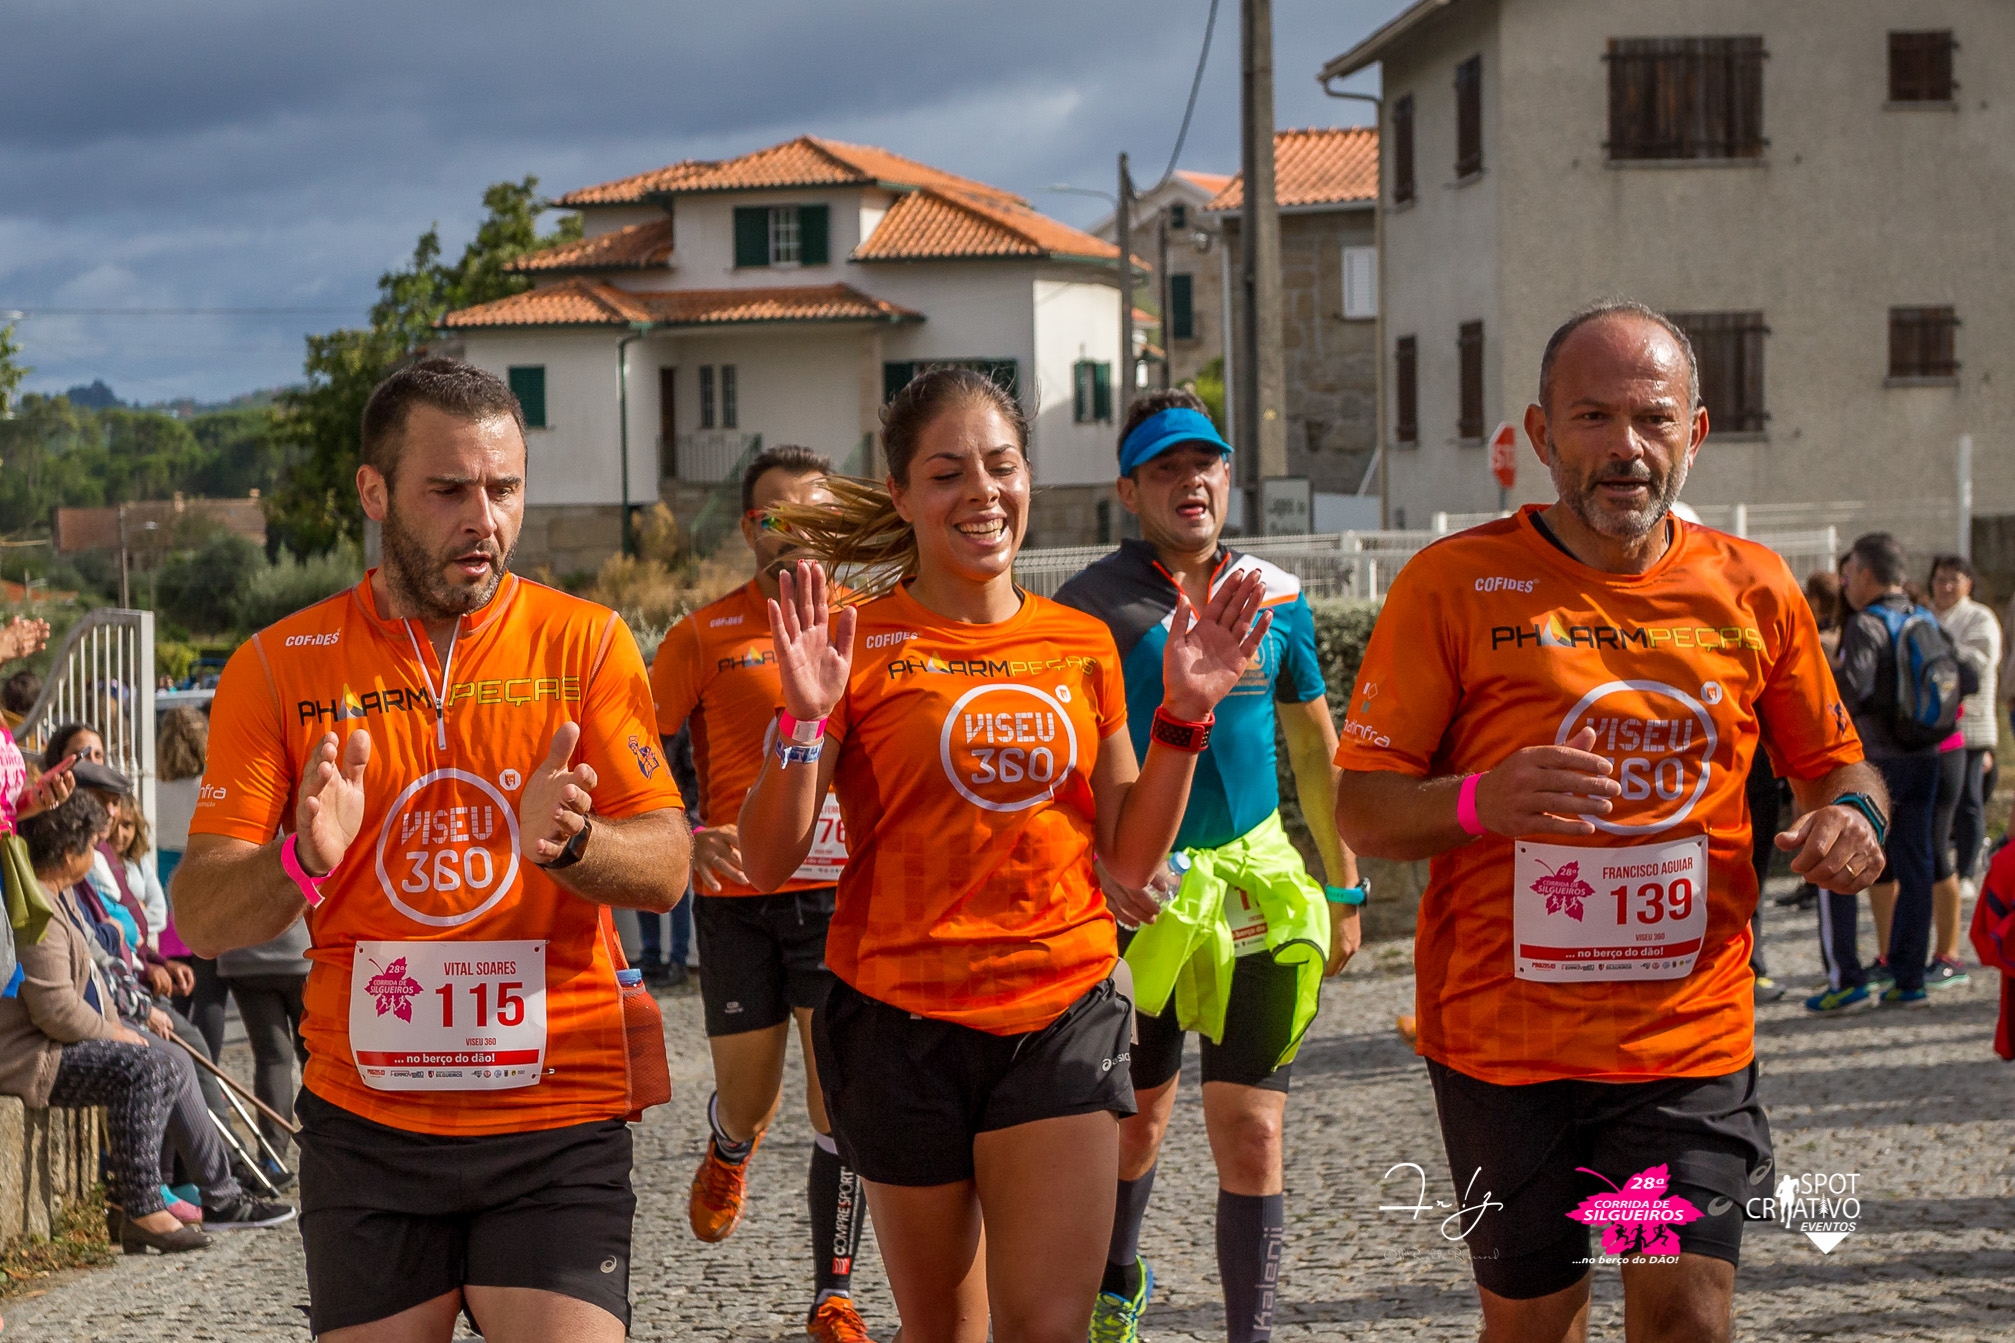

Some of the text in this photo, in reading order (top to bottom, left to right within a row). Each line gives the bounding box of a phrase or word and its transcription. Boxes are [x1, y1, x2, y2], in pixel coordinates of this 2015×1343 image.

[1492, 444, 1515, 470] ST
[1475, 576, 1535, 594] COFIDES
[285, 632, 340, 647] COFIDES
[448, 676, 581, 707] PEÇAS
[965, 711, 1055, 744] VISEU
[971, 746, 1054, 784] 360
[1588, 757, 1684, 801] 60
[401, 805, 493, 846] VISEU
[401, 846, 494, 893] 360
[1602, 857, 1693, 880] FRANCISCO AGUIAR
[1538, 885, 1586, 896] SILGUEIROS
[1610, 878, 1693, 926] 139
[1635, 933, 1653, 942] VISEU
[1593, 949, 1622, 959] berço
[1624, 947, 1638, 957] do
[1640, 946, 1664, 956] dão!
[444, 961, 516, 976] VITAL SOARES
[370, 986, 414, 994] SILGUEIROS
[435, 982, 525, 1028] 115
[465, 1037, 497, 1046] VISEU 360
[406, 1055, 420, 1063] no
[422, 1053, 453, 1066] berço
[455, 1053, 469, 1063] do
[471, 1052, 496, 1063] dão!
